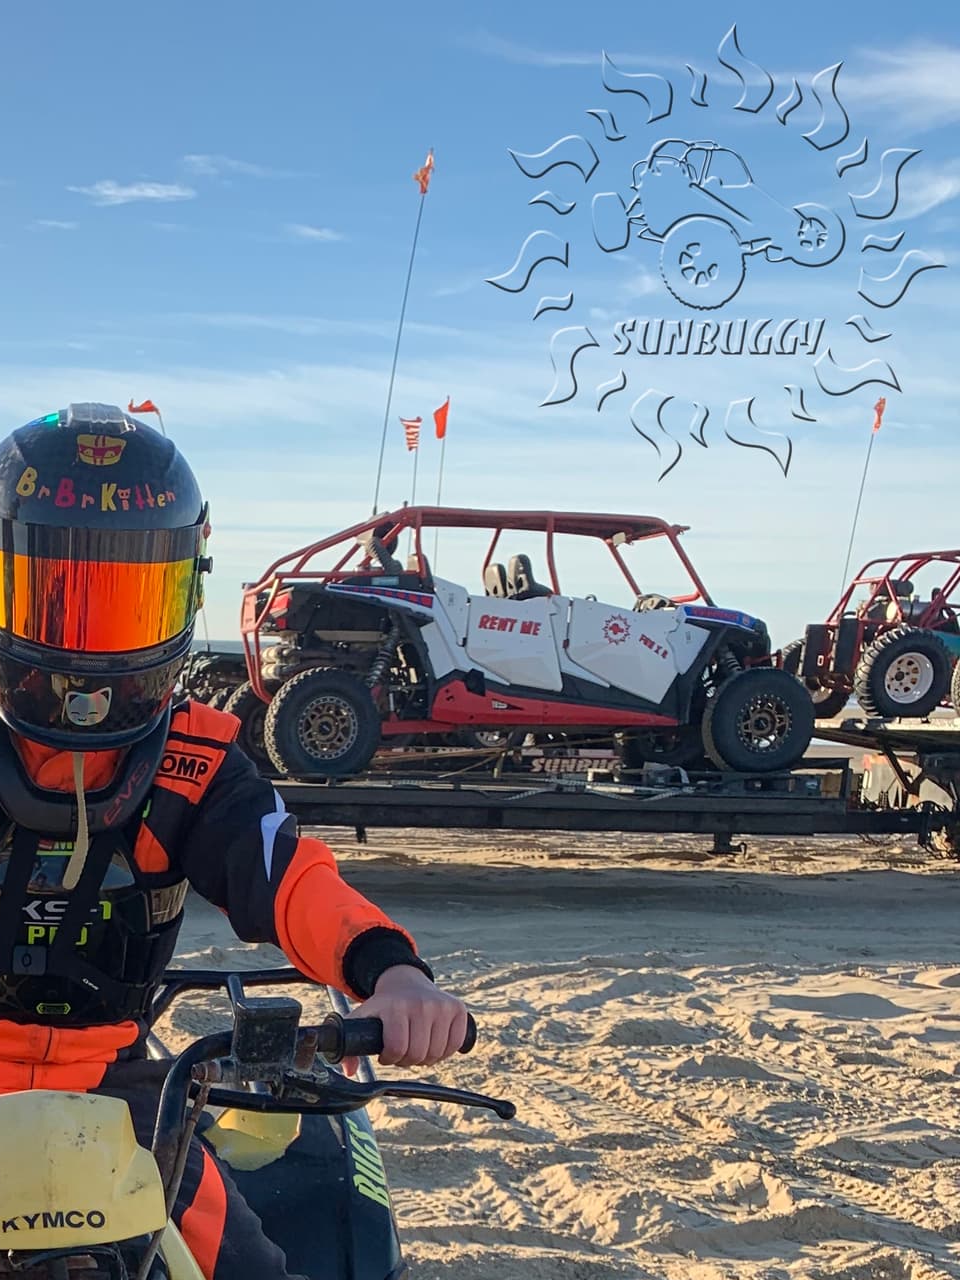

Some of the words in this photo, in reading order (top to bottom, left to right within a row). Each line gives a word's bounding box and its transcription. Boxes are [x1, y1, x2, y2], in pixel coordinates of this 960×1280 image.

[478, 614, 517, 633] RENT
[520, 620, 541, 636] ME
[159, 754, 209, 780] OMP
[2, 1210, 106, 1233] KYMCO
